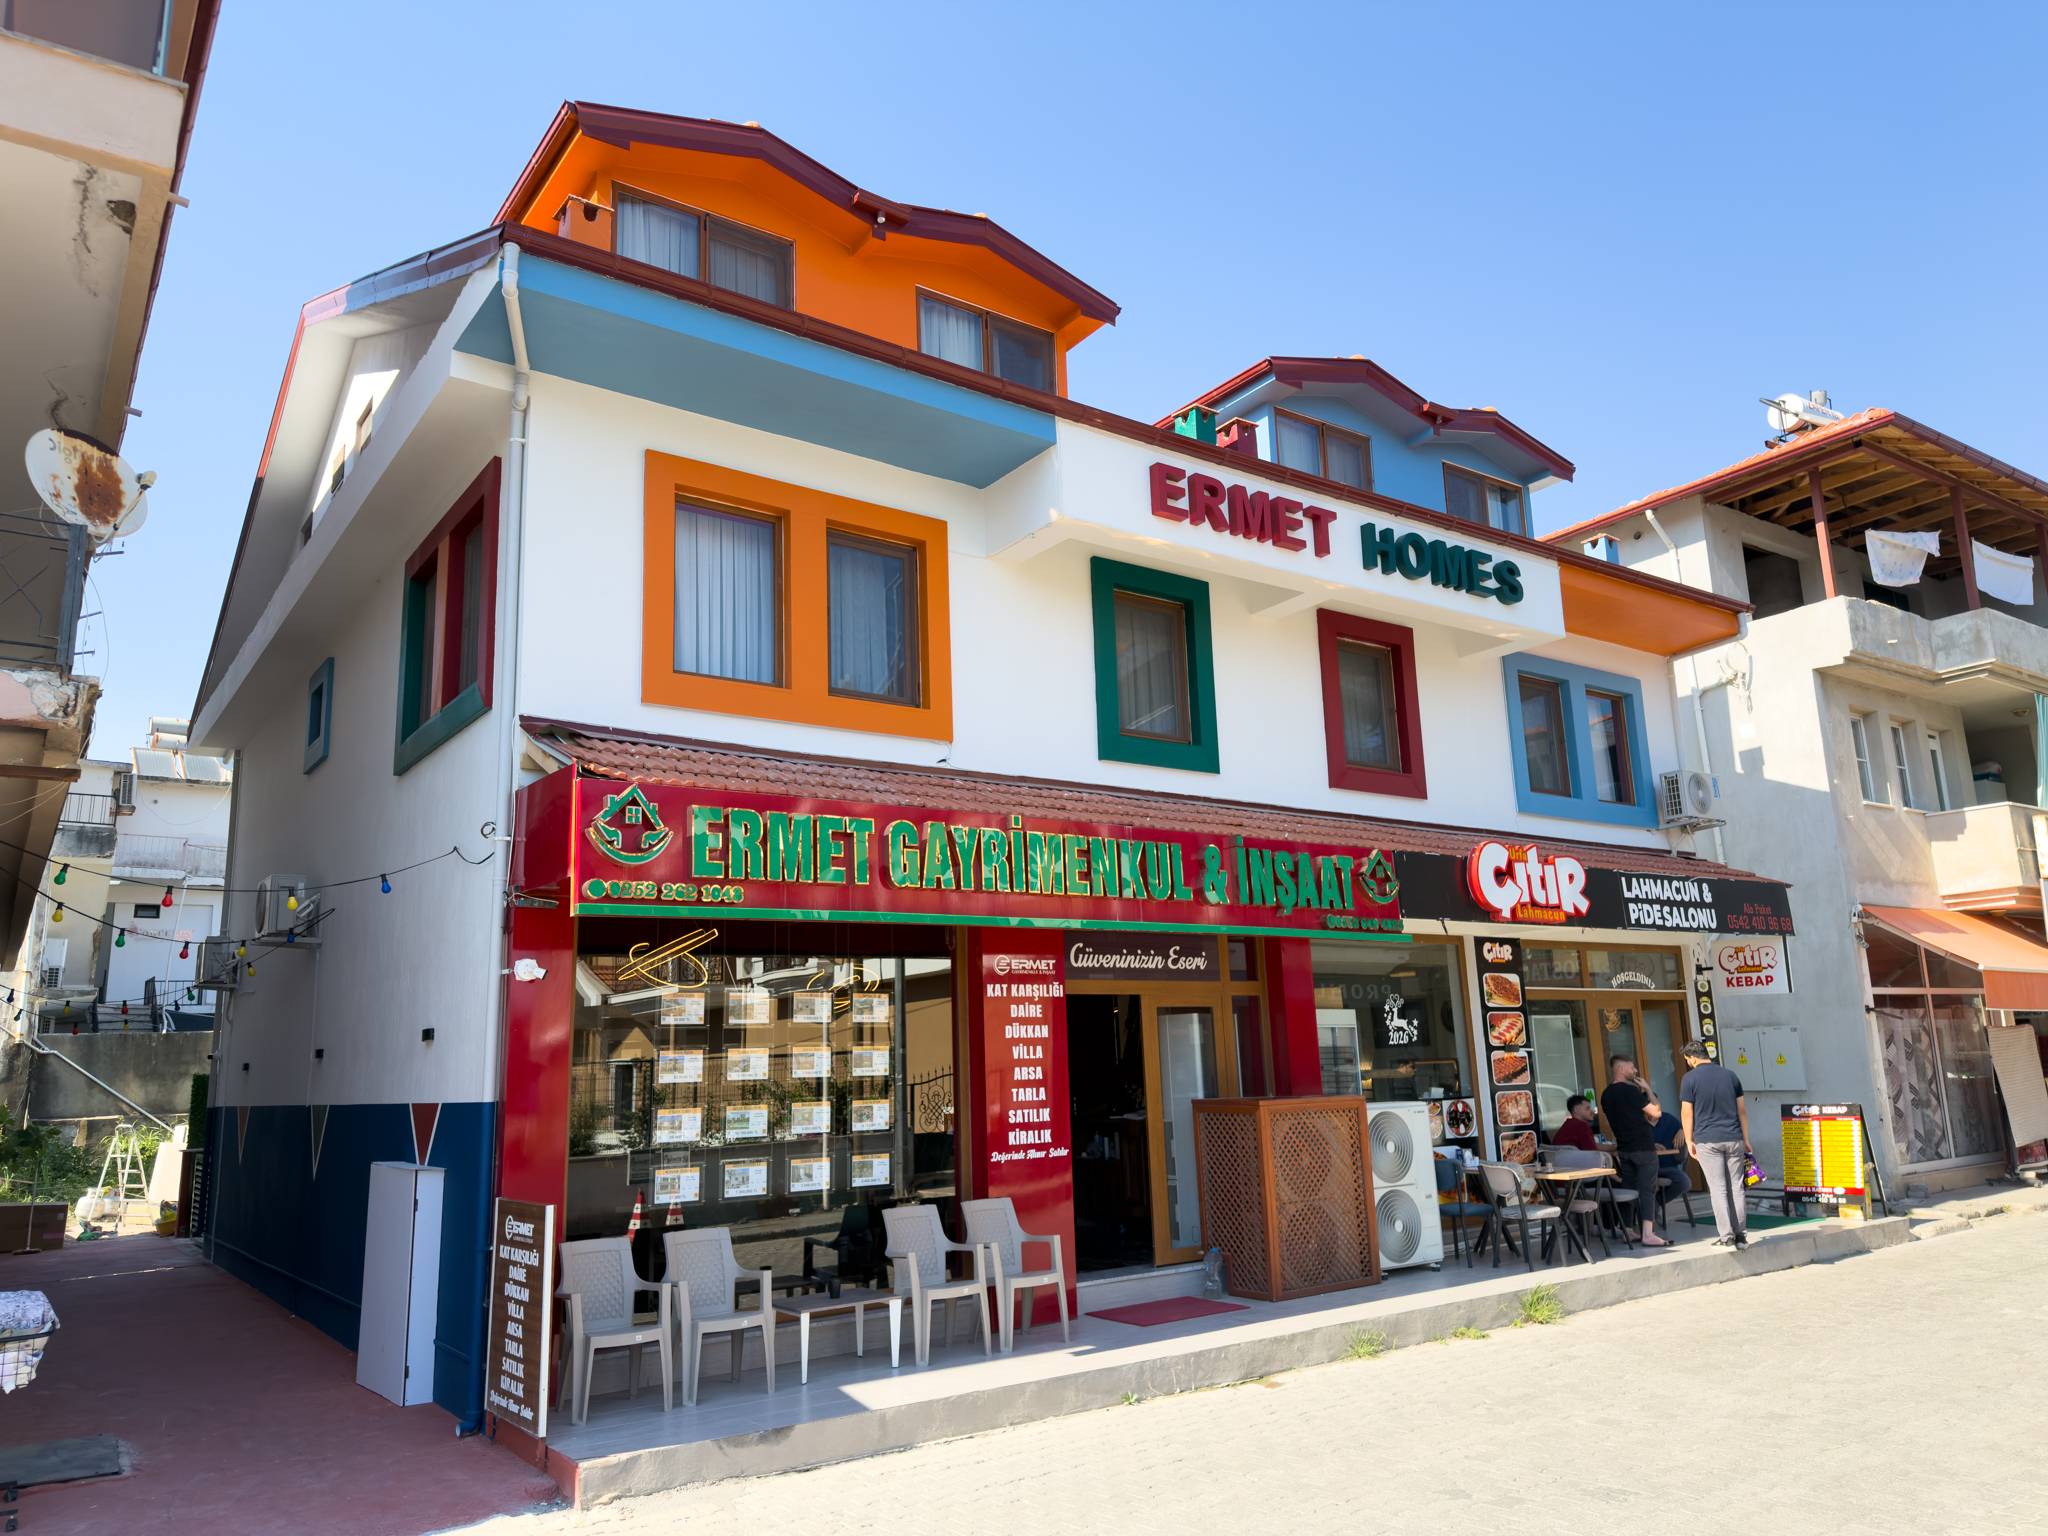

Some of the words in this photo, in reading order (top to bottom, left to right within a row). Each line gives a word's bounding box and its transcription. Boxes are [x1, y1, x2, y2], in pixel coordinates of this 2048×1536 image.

[1149, 461, 1337, 559] ERMET
[1360, 522, 1524, 606] HOMES
[689, 804, 874, 885] ERMET
[885, 812, 1192, 901] GAYRİMENKUL
[1203, 843, 1231, 905] &
[1235, 835, 1355, 915] İNŞAAT
[607, 880, 657, 898] 0252
[661, 883, 697, 901] 262
[1621, 876, 1700, 903] LAHMACUN
[1702, 882, 1712, 904] &
[1663, 905, 1717, 930] SALONU
[1728, 914, 1749, 929] 0542
[1011, 960, 1056, 970] ERMET
[1070, 942, 1165, 969] Güveninizin
[1168, 945, 1208, 971] Eseri
[1726, 975, 1774, 988] KEBAP
[987, 984, 1008, 998] KAT
[1011, 982, 1064, 1001] KARŞILIĞI
[1010, 1001, 1043, 1018] DAİRE
[1005, 1022, 1049, 1039] DÜKKAN
[1388, 1031, 1409, 1045] 2026
[1012, 1043, 1043, 1060] VİLLA
[1013, 1066, 1043, 1081] ARSA
[1011, 1087, 1046, 1102] TARLA
[1008, 1107, 1050, 1123] SATILIK
[1008, 1128, 1052, 1146] KİRALIK
[499, 1244, 510, 1259] KAT
[504, 1282, 529, 1302] DÜKKAN
[507, 1300, 524, 1320] VİLLA
[506, 1320, 523, 1339] ARSA
[504, 1338, 523, 1359] TARLA
[501, 1357, 524, 1379] SATILIK
